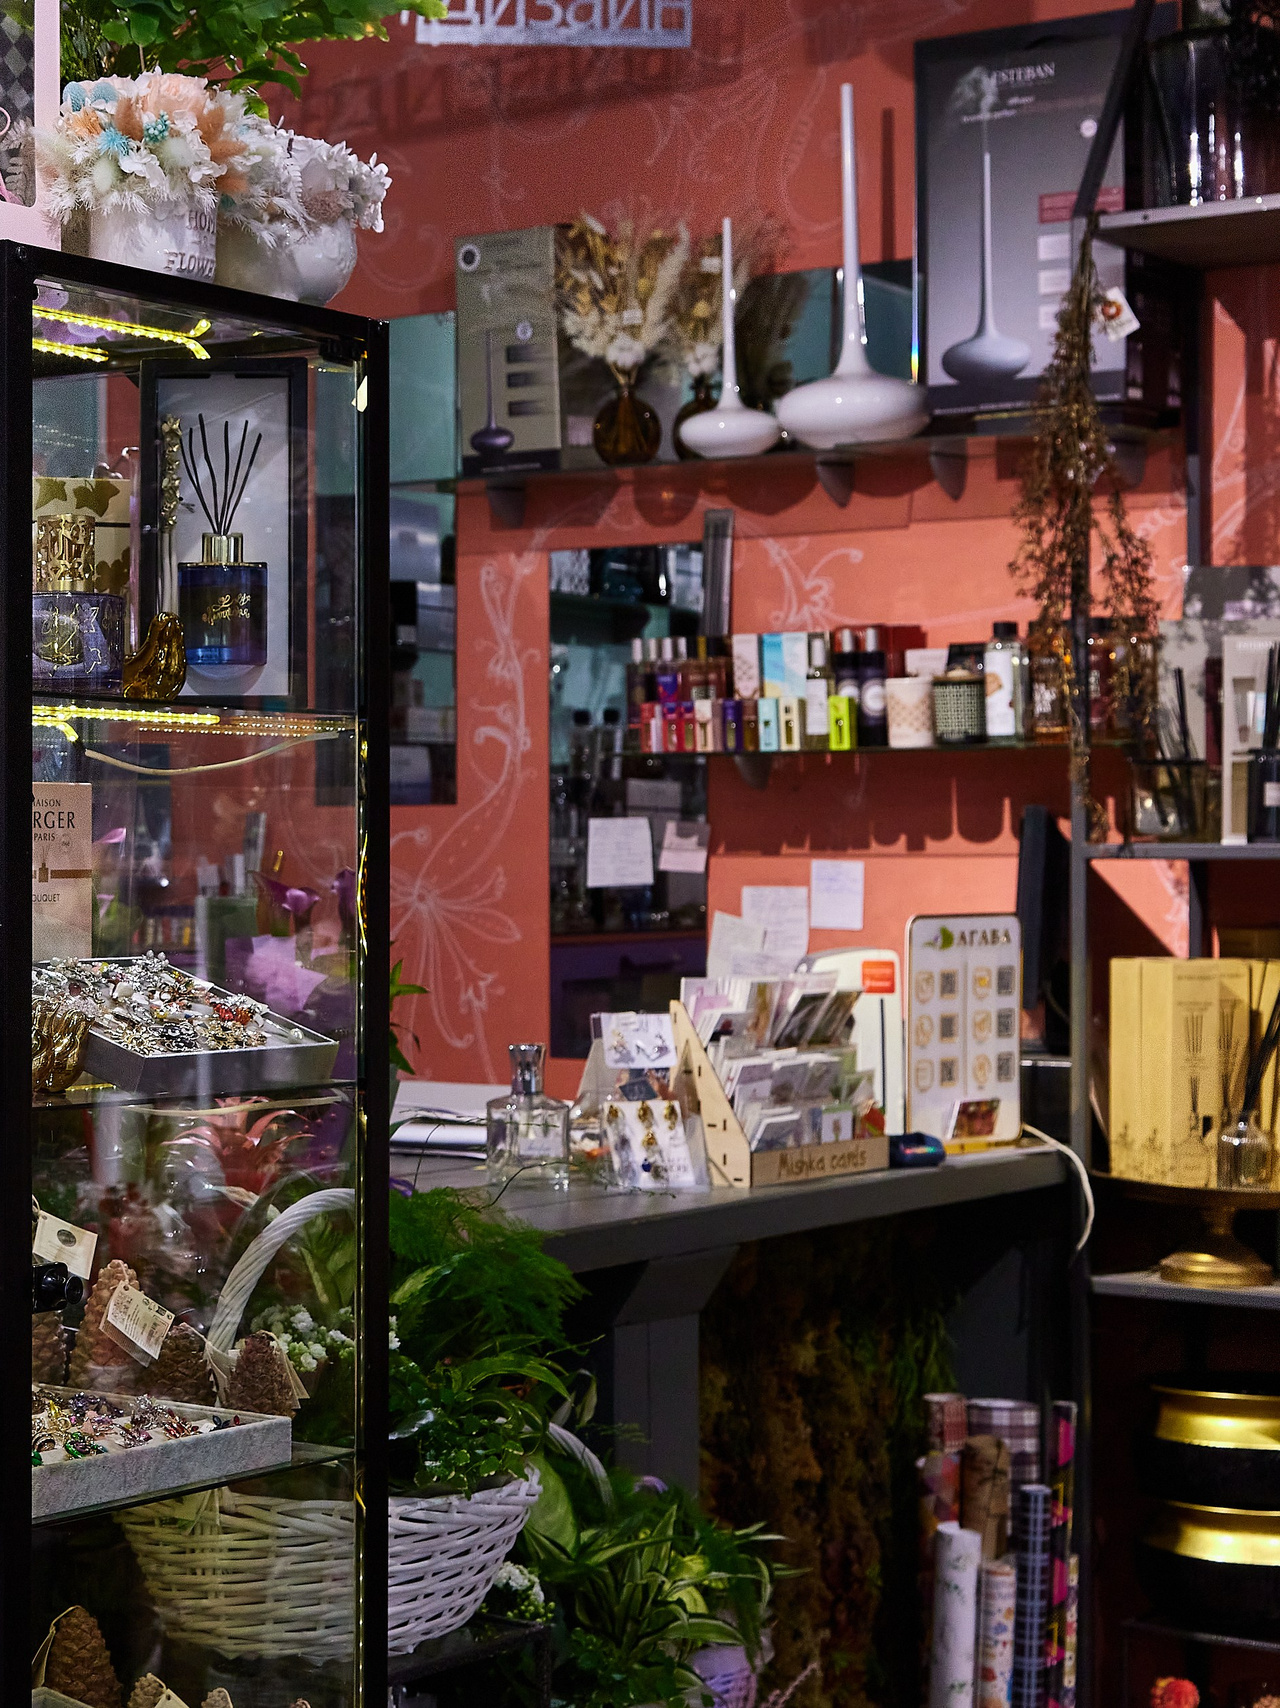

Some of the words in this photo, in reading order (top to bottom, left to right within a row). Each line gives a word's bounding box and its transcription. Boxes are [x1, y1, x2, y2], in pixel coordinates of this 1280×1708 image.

[33, 810, 76, 829] RGER
[34, 832, 56, 842] PARIS
[32, 893, 60, 903] OUQUET
[957, 928, 1012, 946] АГАВА
[830, 1143, 867, 1169] cards
